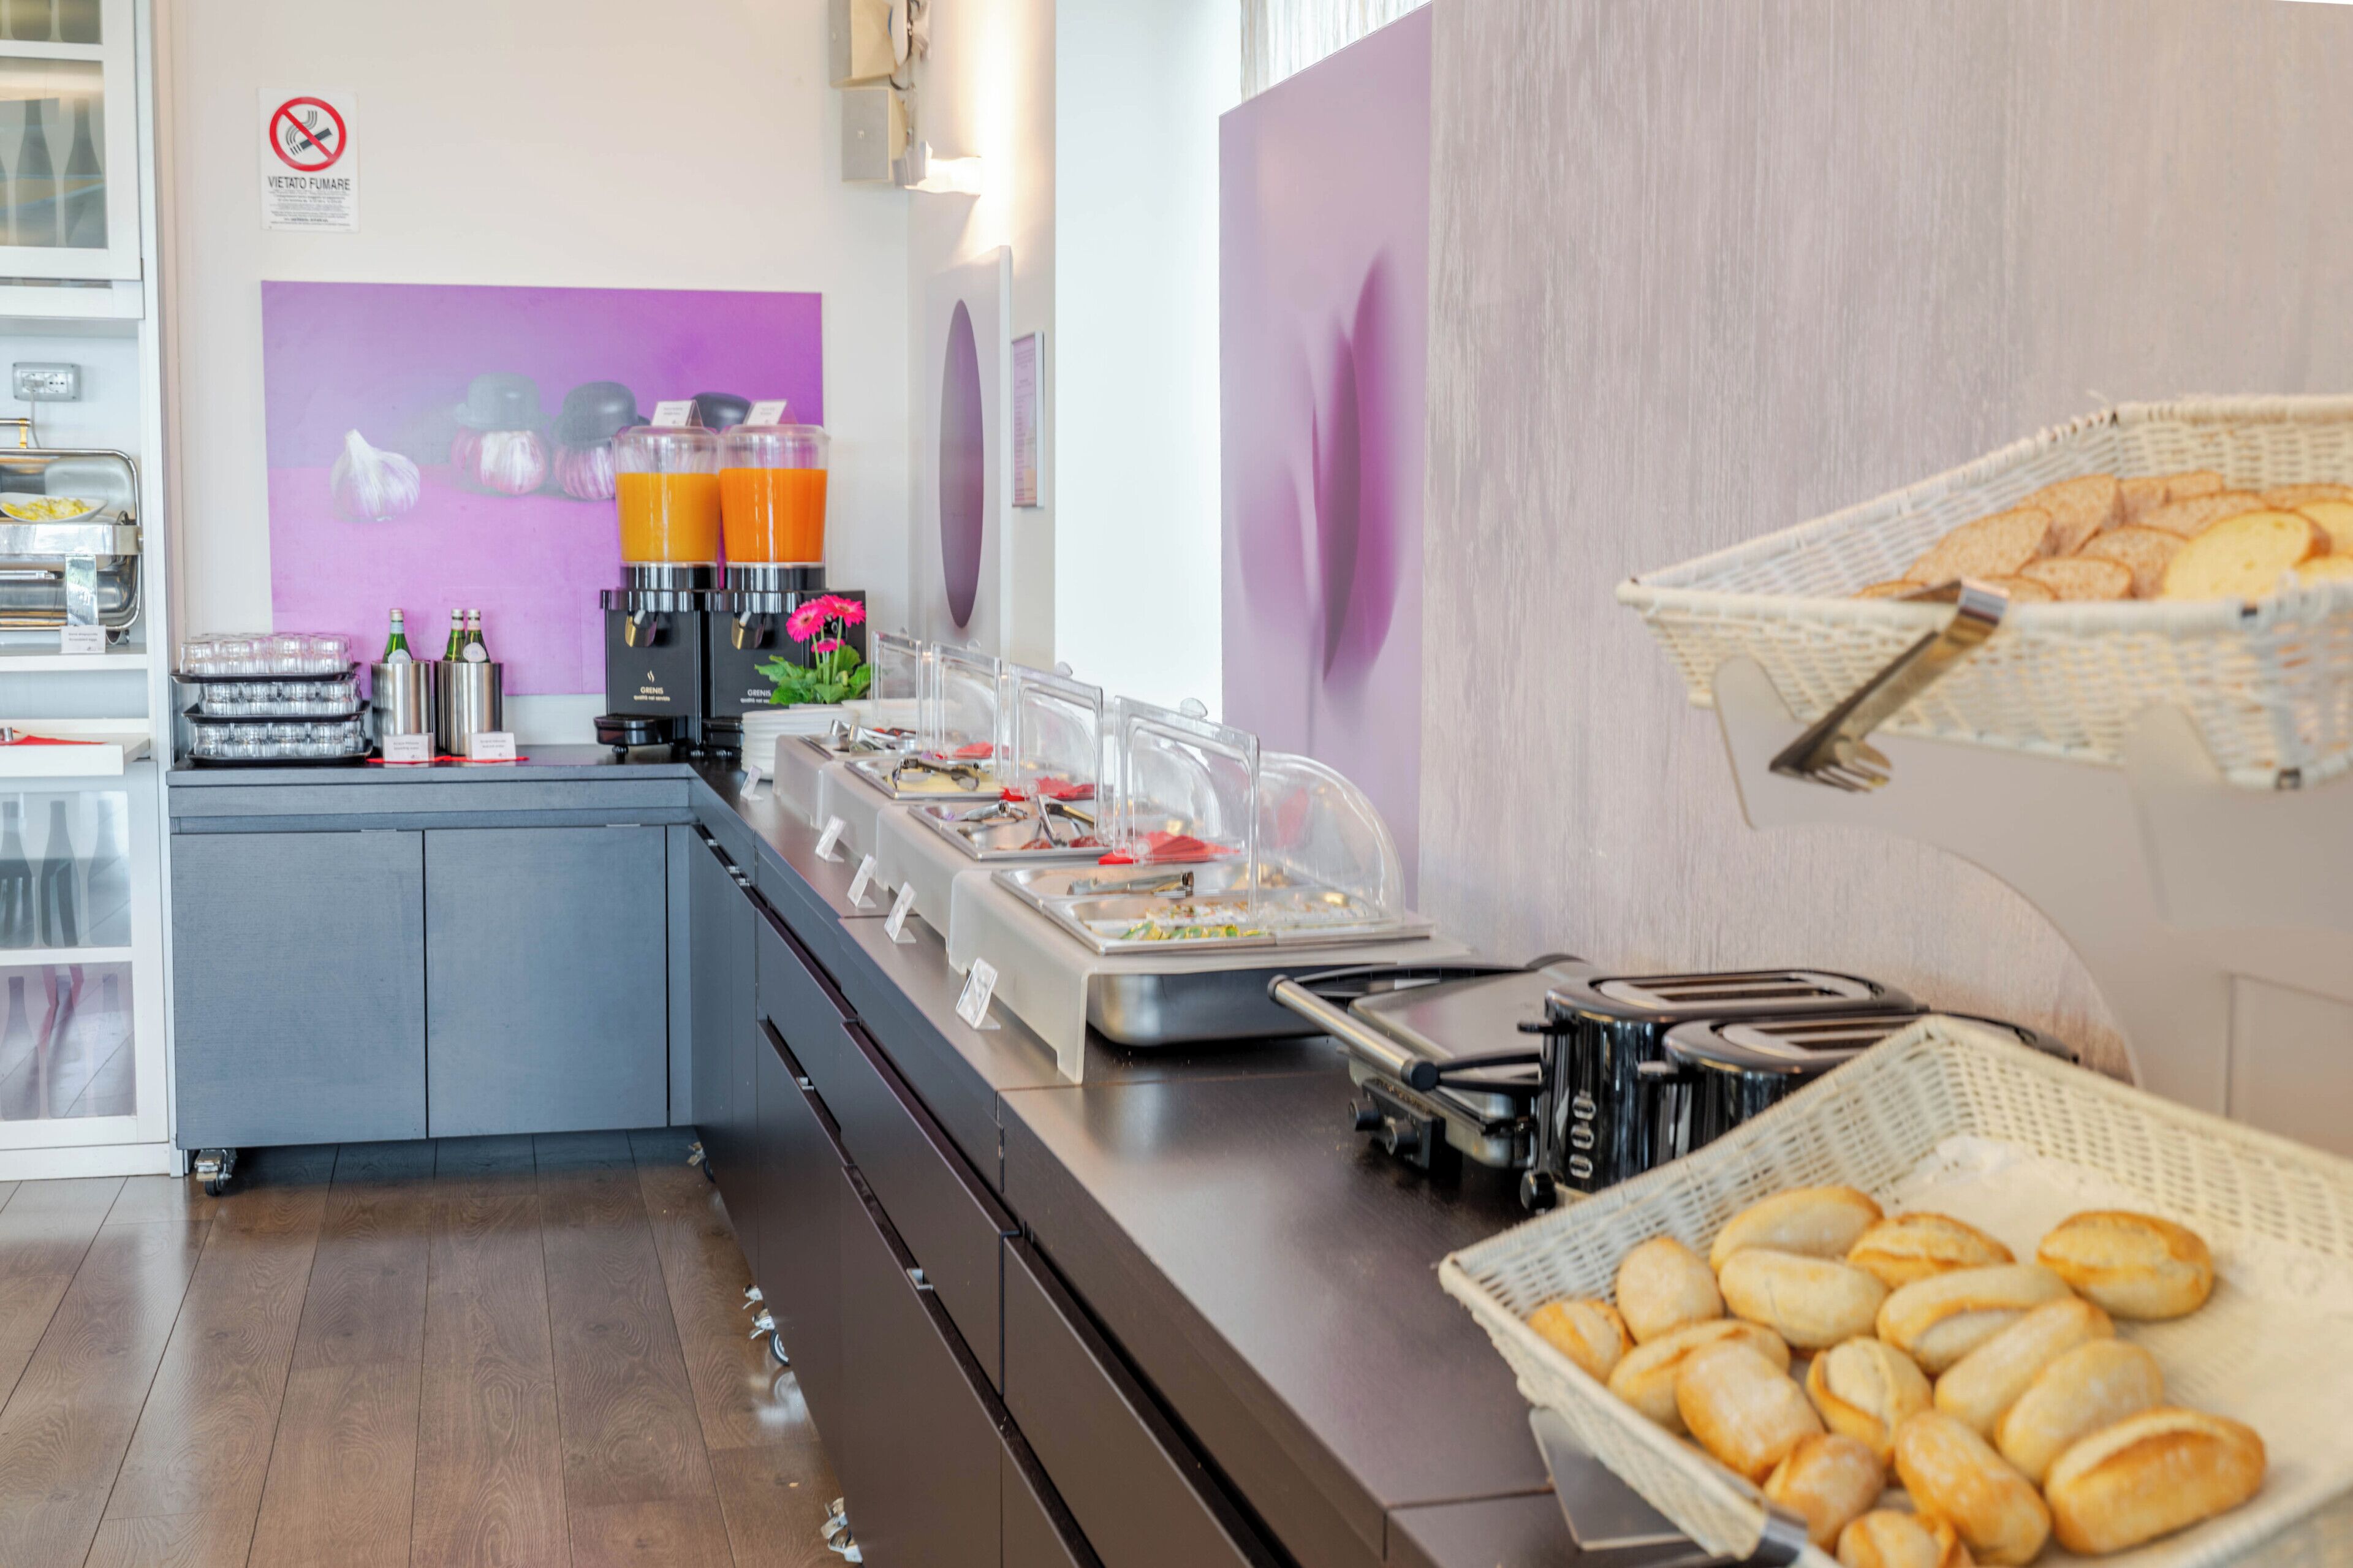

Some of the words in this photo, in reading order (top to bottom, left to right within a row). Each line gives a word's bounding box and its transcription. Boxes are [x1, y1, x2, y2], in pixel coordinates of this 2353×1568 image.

[268, 176, 306, 189] VIETATO
[309, 178, 350, 191] FUMARE
[640, 686, 664, 695] GRENIS
